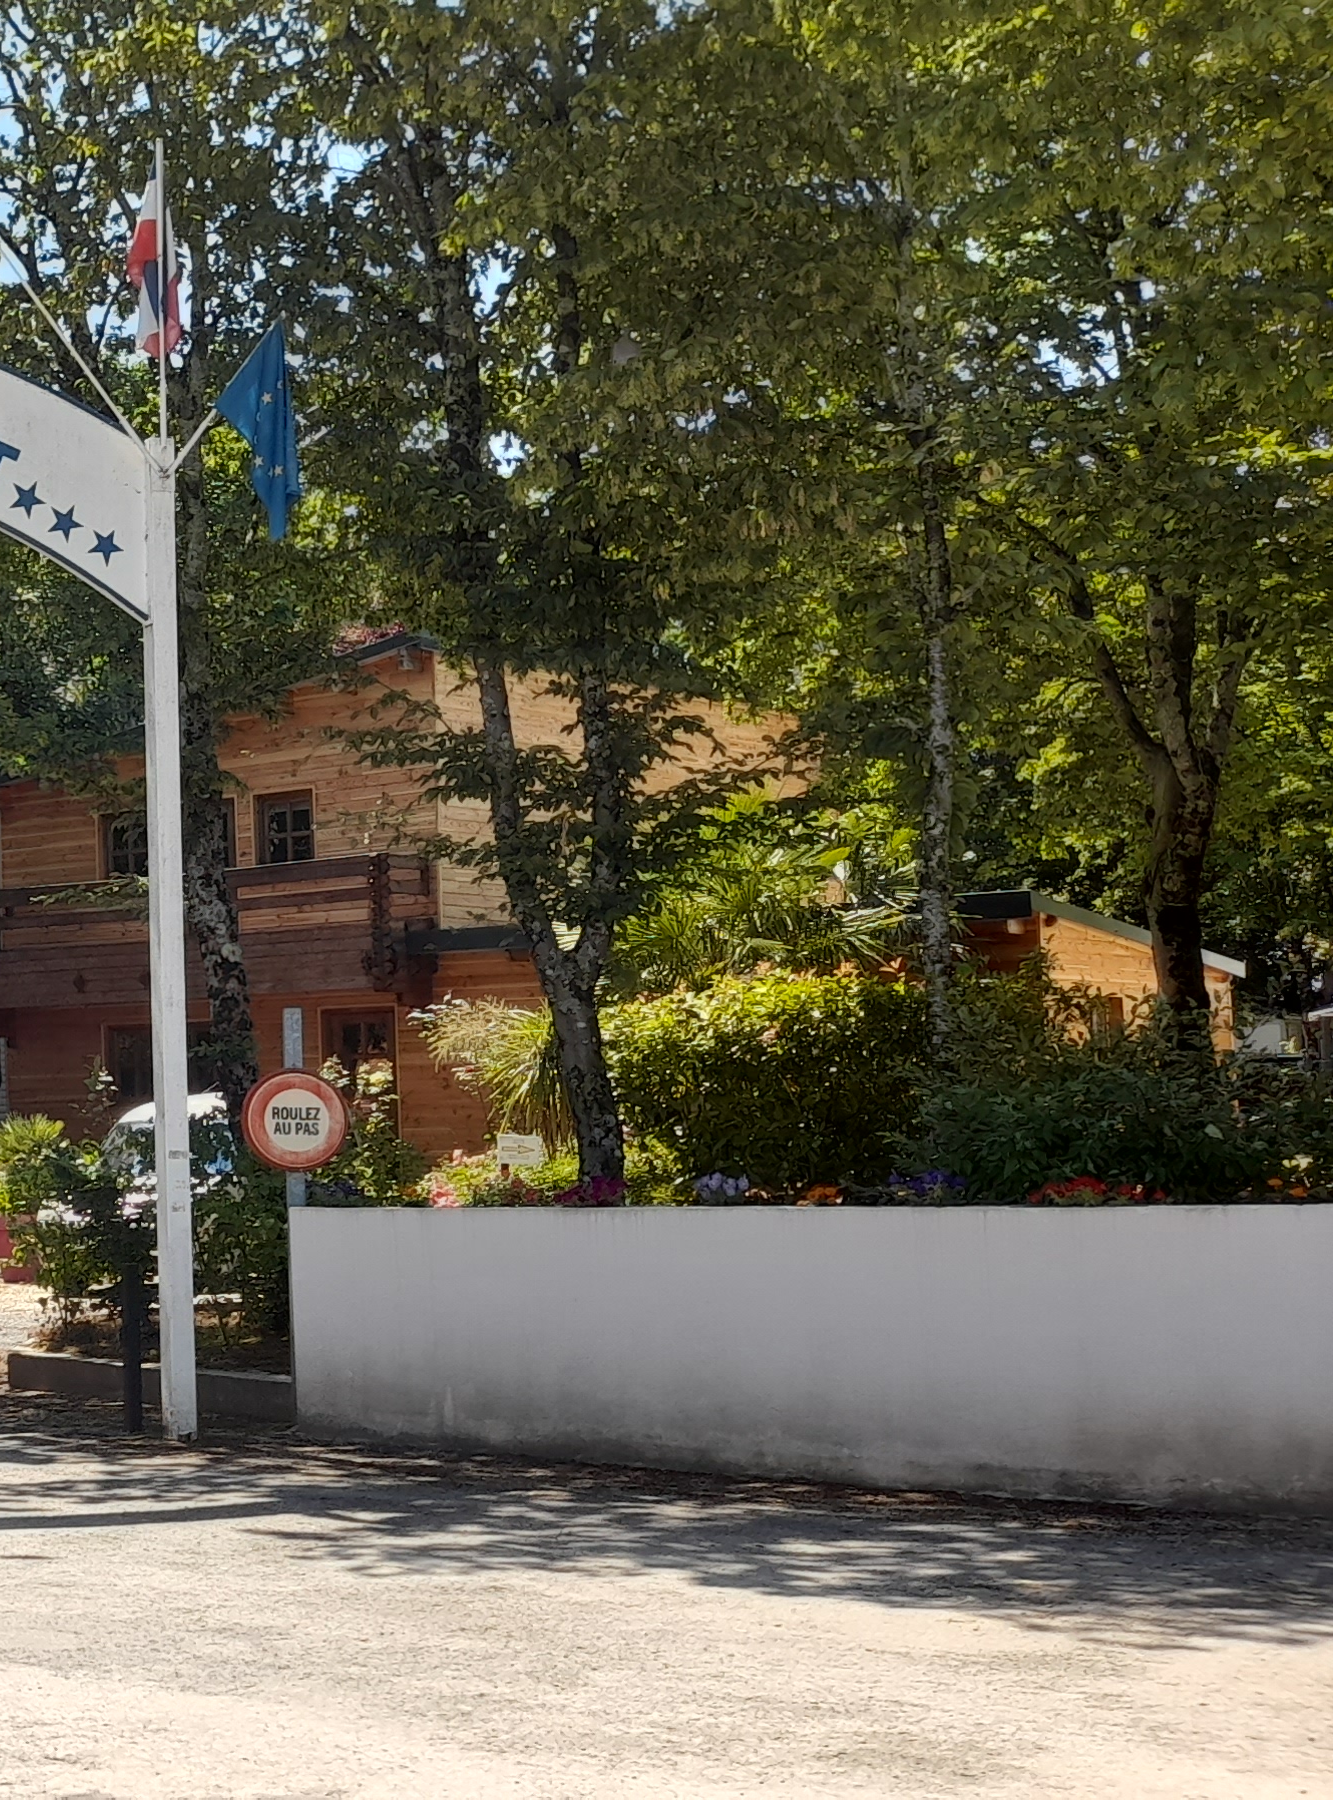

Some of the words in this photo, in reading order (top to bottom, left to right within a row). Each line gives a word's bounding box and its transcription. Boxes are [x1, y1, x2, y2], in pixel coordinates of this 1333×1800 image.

[272, 1106, 320, 1120] ROULEZ
[273, 1122, 291, 1135] AU
[295, 1122, 319, 1136] PAS
